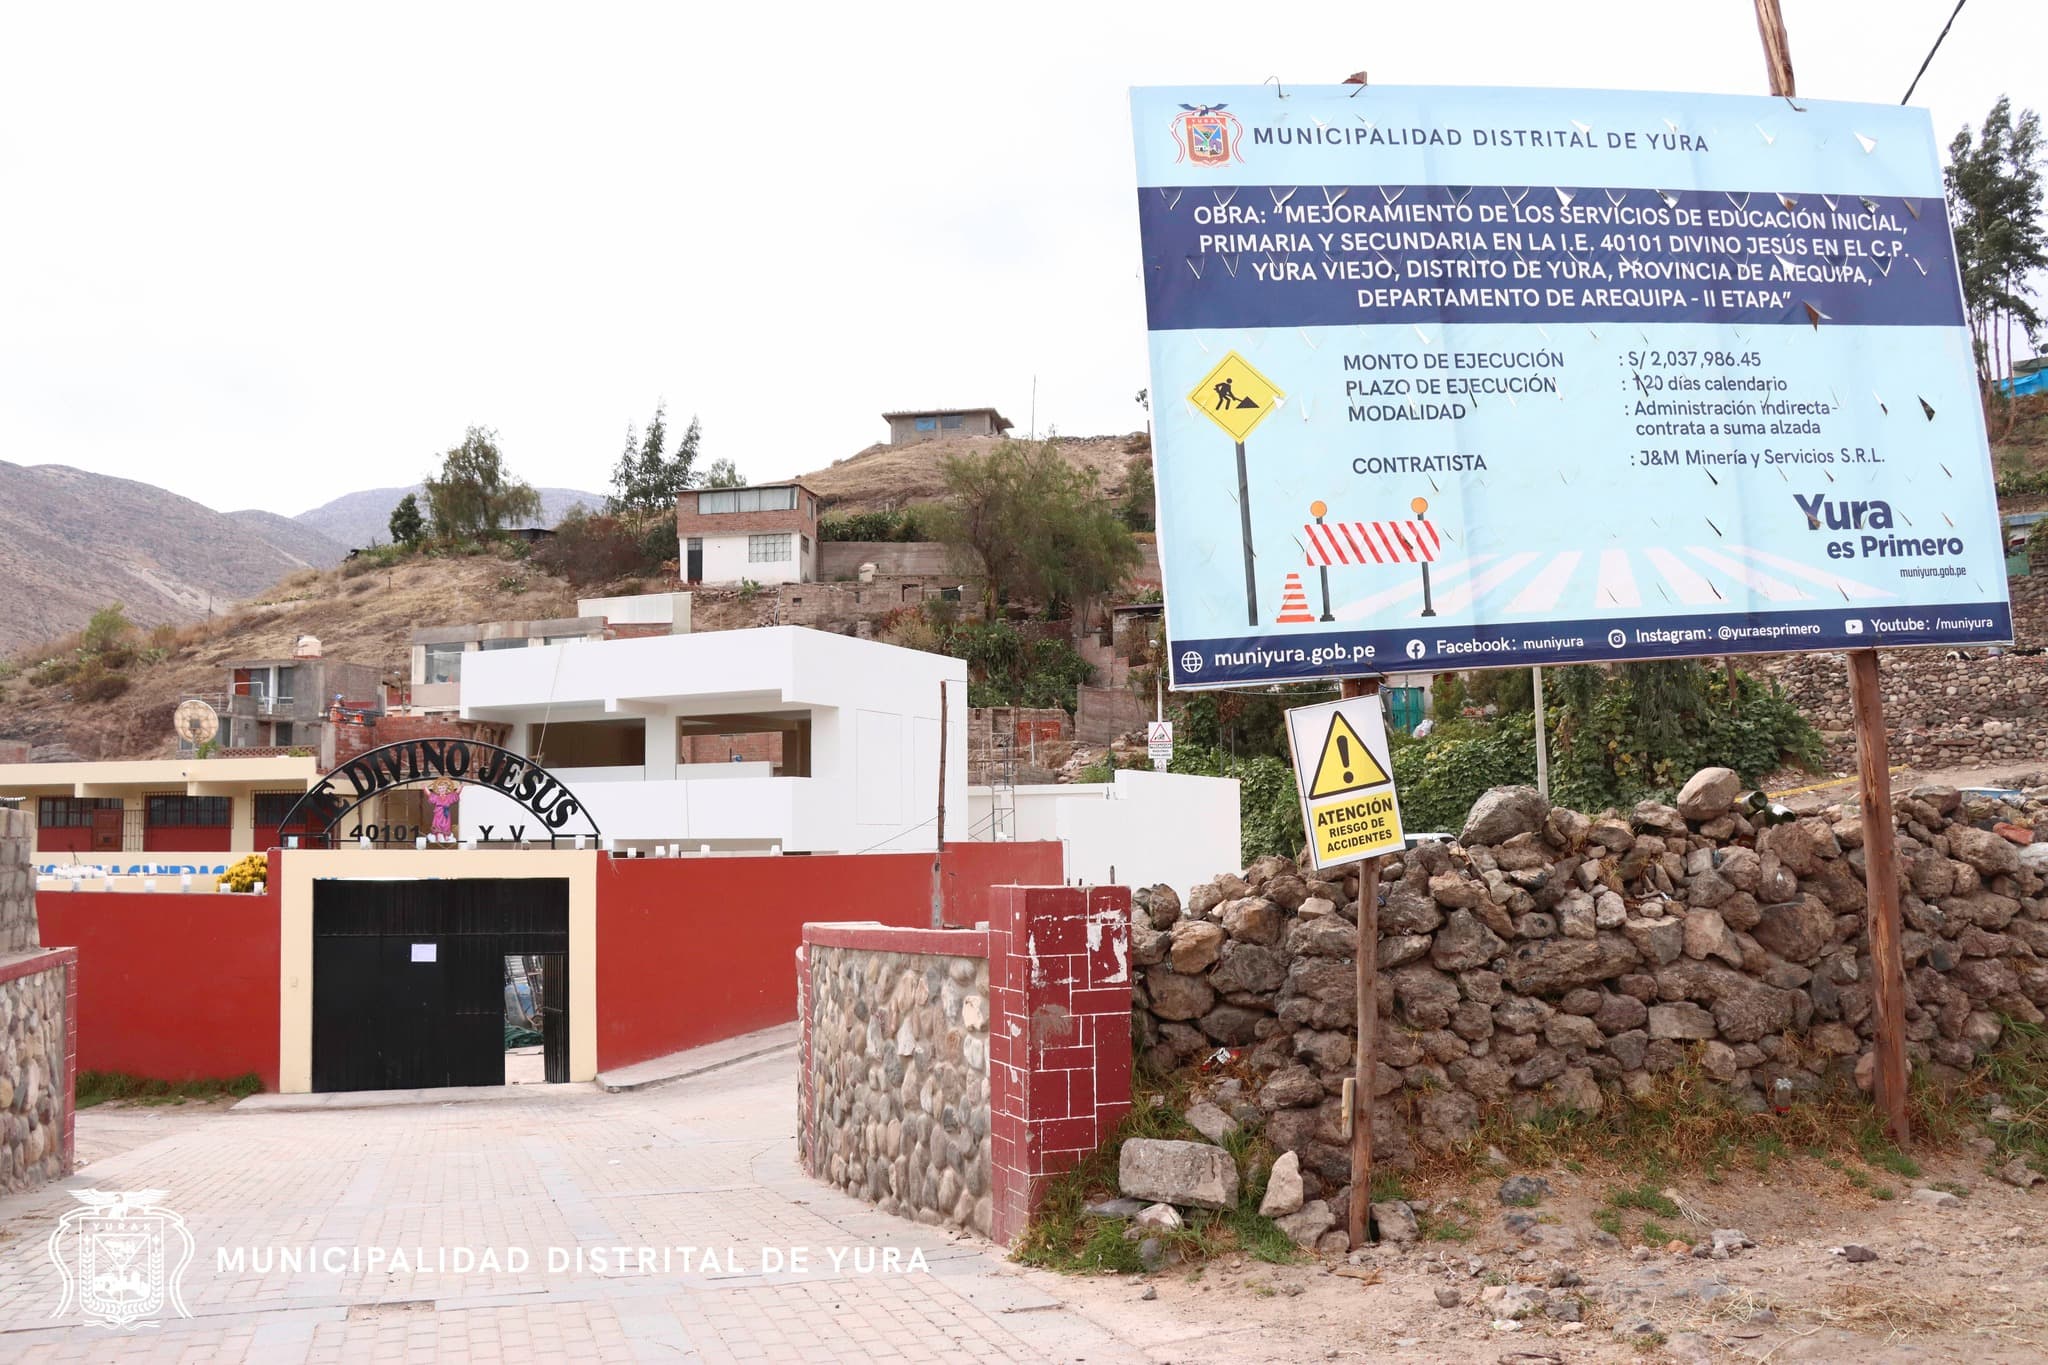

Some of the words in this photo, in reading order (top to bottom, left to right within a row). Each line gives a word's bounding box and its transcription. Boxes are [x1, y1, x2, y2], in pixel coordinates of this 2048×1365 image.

[1253, 127, 1462, 146] MUNICIPALIDAD
[1473, 129, 1598, 148] DISTRITAL
[1607, 131, 1636, 149] DE
[1645, 133, 1709, 153] YURA
[1193, 206, 1267, 224] OBRA:
[1479, 205, 1509, 223] DE
[1514, 205, 1555, 223] LOS
[1560, 206, 1671, 226] SERVICIOS
[1675, 208, 1702, 226] DE
[1708, 207, 1827, 229] EDUCACIÓN
[1831, 213, 1908, 234] INICIAL,
[1200, 233, 1314, 253] PRIMARIA
[1317, 233, 1335, 252] Y
[1341, 232, 1488, 251] SECUNDARIA
[1493, 232, 1525, 251] EN
[1529, 232, 1556, 251] LA
[1561, 233, 1595, 252] I.E.
[1600, 233, 1662, 253] 40101
[1669, 235, 1742, 255] DIVINO
[1747, 232, 1808, 256] JESÚS
[1813, 239, 1839, 257] EN
[1845, 240, 1868, 257] EL
[1871, 240, 1909, 258] C.P.
[1252, 261, 1317, 281] YURA
[1322, 260, 1401, 282] VIEJO,
[1407, 260, 1509, 279] DISTRITO
[1513, 260, 1541, 279] DE
[1547, 261, 1613, 283] YURA,
[1618, 261, 1732, 281] PROVINCIA
[1737, 263, 1764, 281] DE
[1769, 263, 1873, 287] AREQUIPA,
[1358, 288, 1540, 308] DEPARTAMENTO
[1547, 289, 1575, 307] DE
[1581, 289, 1687, 308] AREQUIPA
[1704, 290, 1715, 307] II
[1343, 353, 1418, 371] MONTO
[1424, 353, 1450, 369] DE
[1454, 348, 1565, 369] EJECUCIÓN
[1650, 351, 1761, 369] 2,037,986.45
[1346, 379, 1411, 397] PLAZO
[1416, 379, 1441, 395] DE
[1447, 373, 1557, 395] EJECUCIÓN
[1633, 375, 1664, 392] 120
[1668, 375, 1701, 391] días
[1704, 376, 1788, 391] calendario
[1348, 404, 1466, 422] MODALIDAD
[1634, 400, 1756, 416] Administración
[1636, 421, 1706, 436] contrata
[1709, 424, 1719, 435] a
[1723, 424, 1766, 435] suma
[1770, 420, 1821, 435] alzada
[1352, 454, 1488, 475] CONTRATISTA
[1639, 450, 1679, 466] J&M
[1685, 450, 1748, 465] Minería
[1750, 453, 1760, 468] y
[1764, 448, 1834, 465] Servicios
[1841, 448, 1885, 463] S.R.L.
[1793, 493, 1894, 531] Yura
[1827, 541, 1855, 559] es
[1861, 534, 1964, 558] Primero
[1900, 565, 1967, 579] muniyura.gob.pe
[1215, 643, 1376, 667] muniyura.gob.pe
[1436, 636, 1516, 654] Facebook:
[1523, 635, 1584, 651] muniyura
[1636, 626, 1713, 645] Instagram:
[1718, 622, 1821, 641] @yuraesprimero
[1870, 617, 1930, 633] Youtube:
[1935, 616, 1993, 631] /muniyura
[342, 740, 469, 800] DIVINO
[478, 752, 579, 829] JESUS
[1317, 797, 1393, 827] ATENCIÓN
[349, 824, 420, 841] 40101
[1329, 820, 1368, 838] RIESGO
[1371, 817, 1385, 829] DE
[1327, 829, 1392, 853] ACCIDENTES
